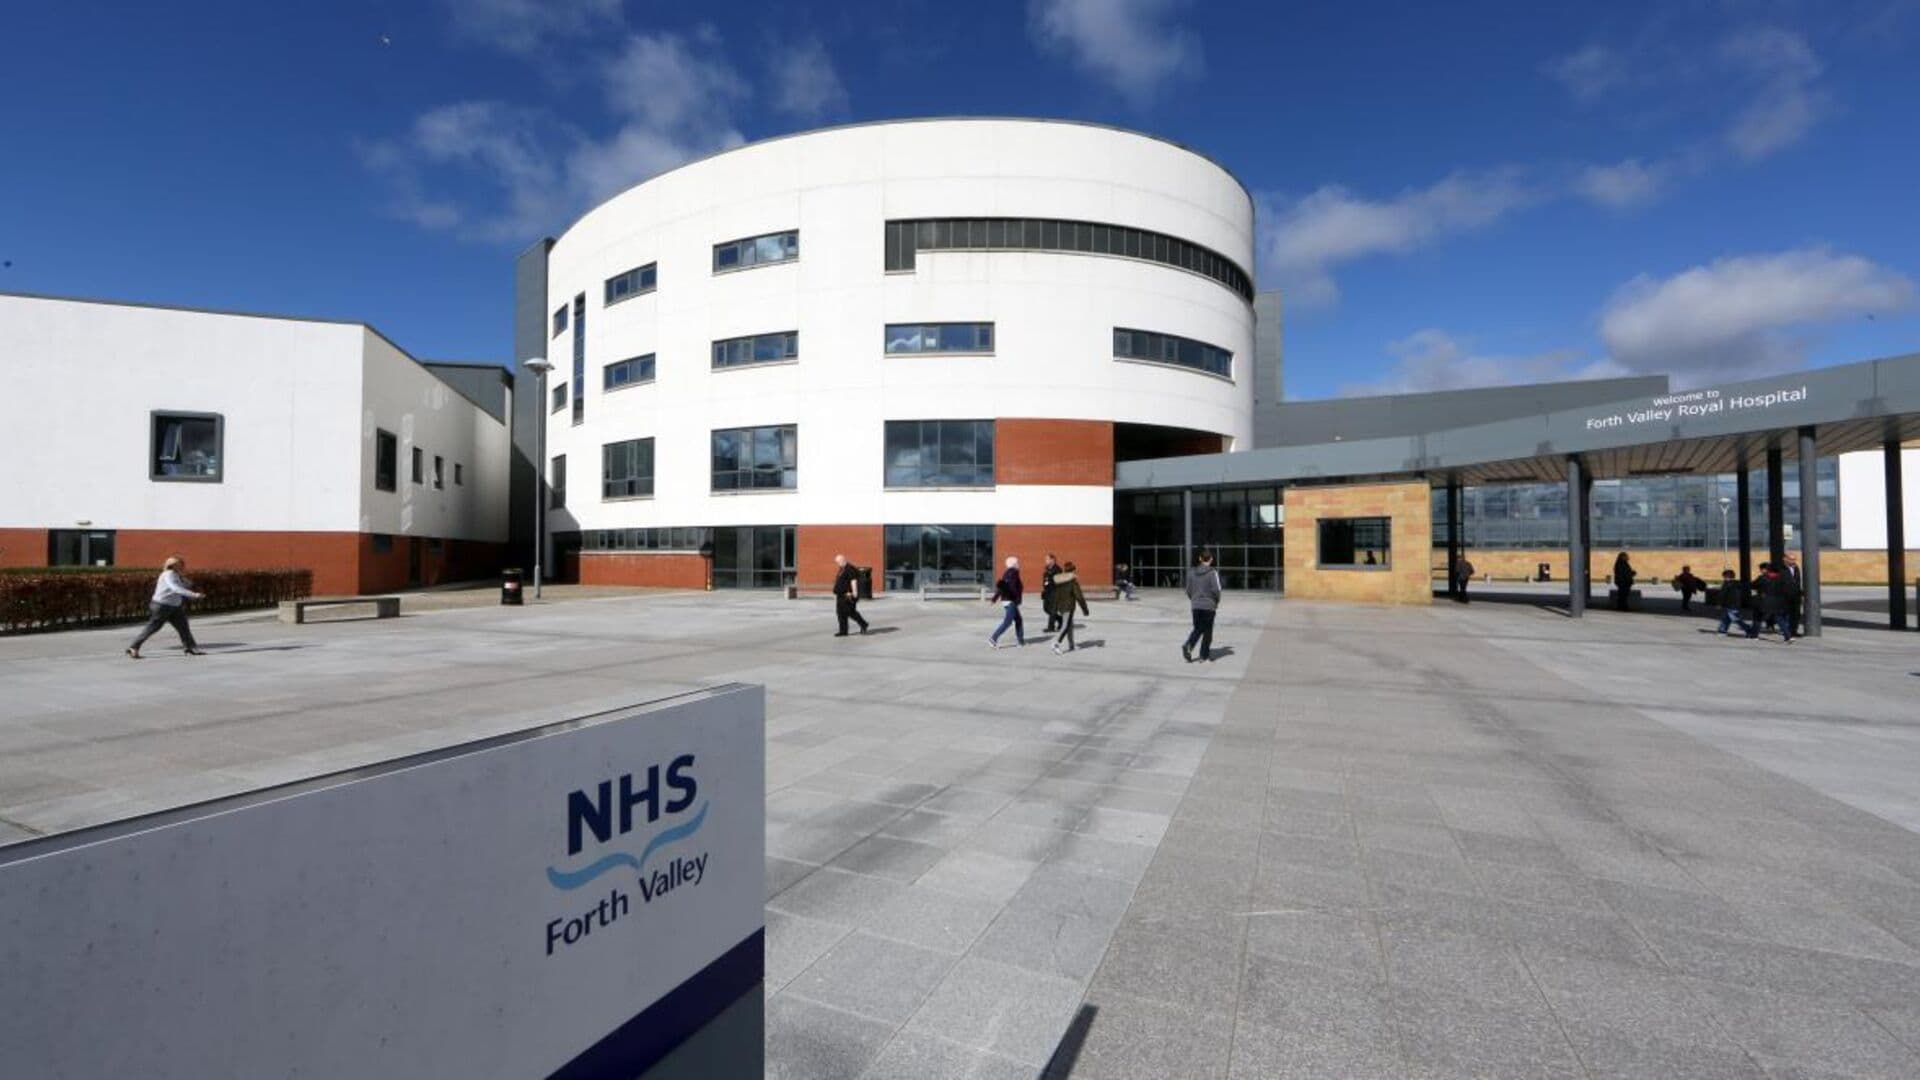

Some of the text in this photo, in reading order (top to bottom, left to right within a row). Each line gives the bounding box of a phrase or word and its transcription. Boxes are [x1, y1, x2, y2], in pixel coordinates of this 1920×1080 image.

[1586, 386, 1807, 430] Forth Valley Royal Hospital
[1653, 389, 1720, 407] Welcome to
[568, 754, 697, 856] NHS
[546, 852, 709, 956] Forth Valley
